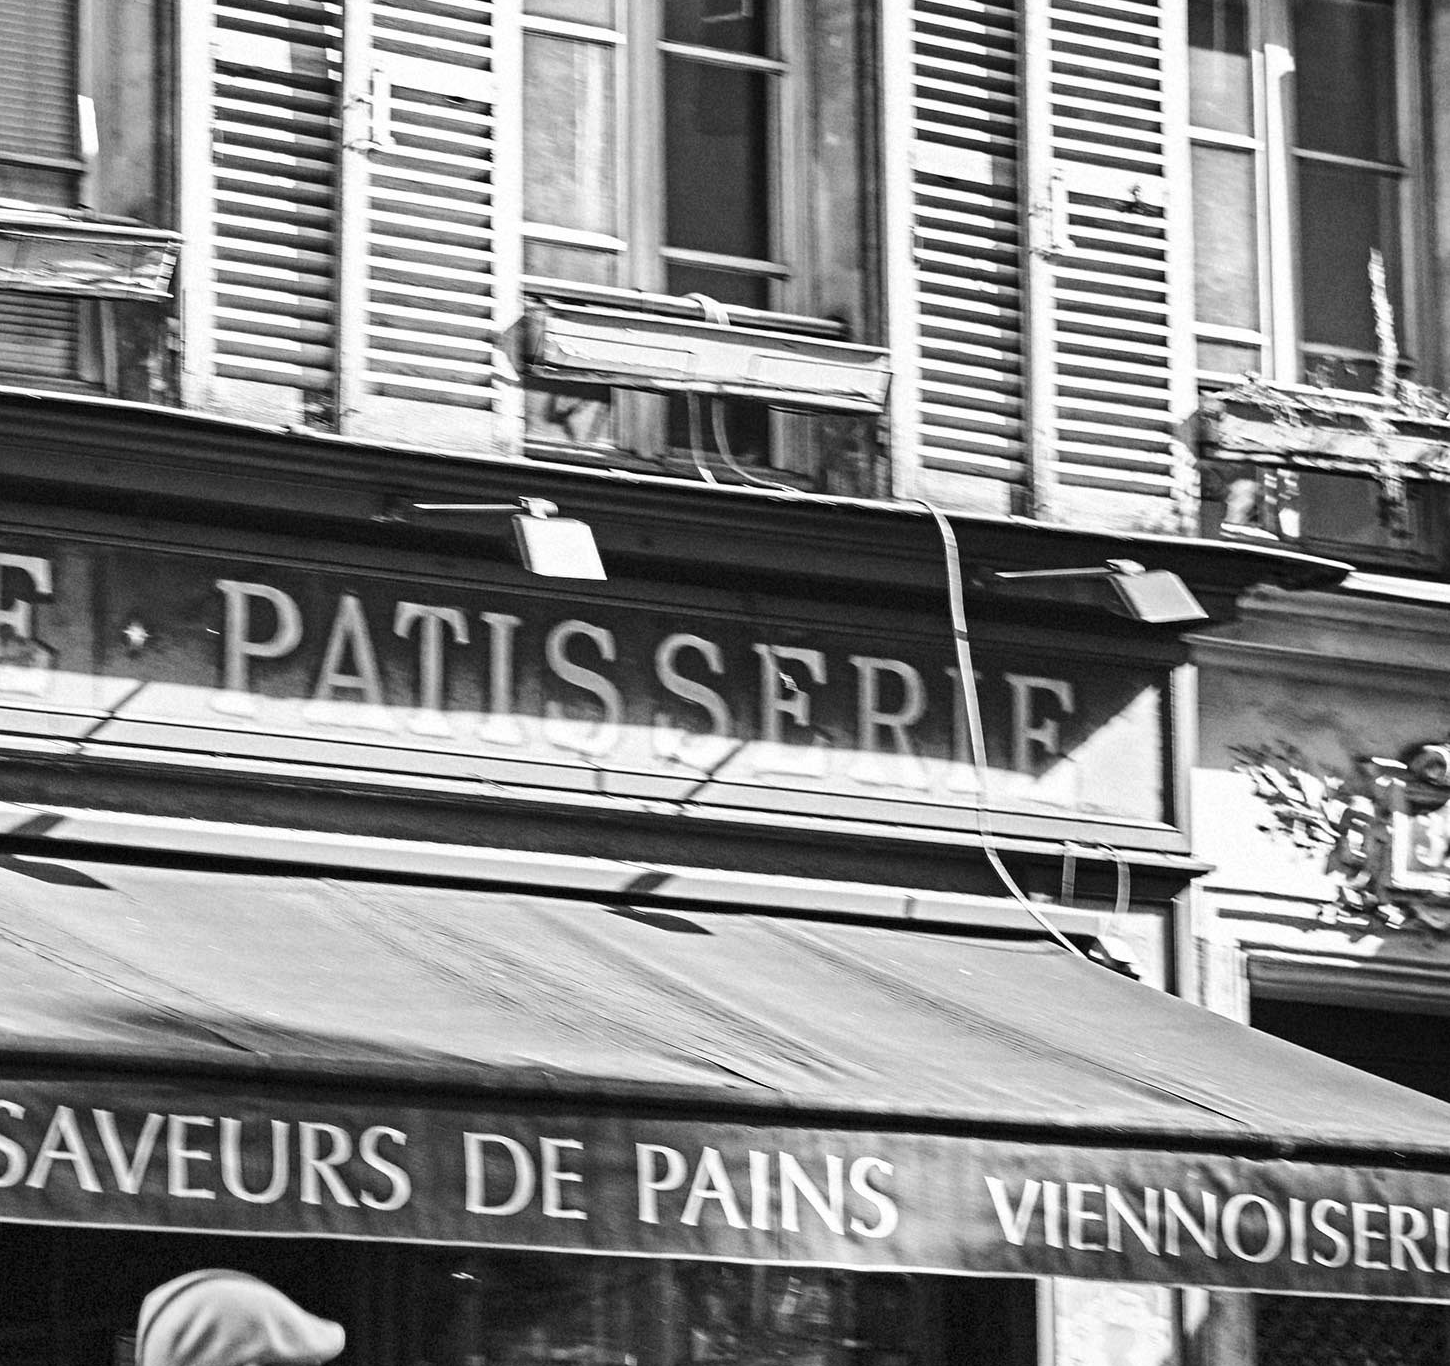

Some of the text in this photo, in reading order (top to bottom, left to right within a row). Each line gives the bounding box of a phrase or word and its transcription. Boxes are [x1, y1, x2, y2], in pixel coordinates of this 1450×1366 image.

[209, 578, 1076, 806] PATISSERIE
[462, 1130, 589, 1221] DE
[633, 1141, 901, 1239] PAINS
[984, 1175, 1450, 1274] VIENNOISERI
